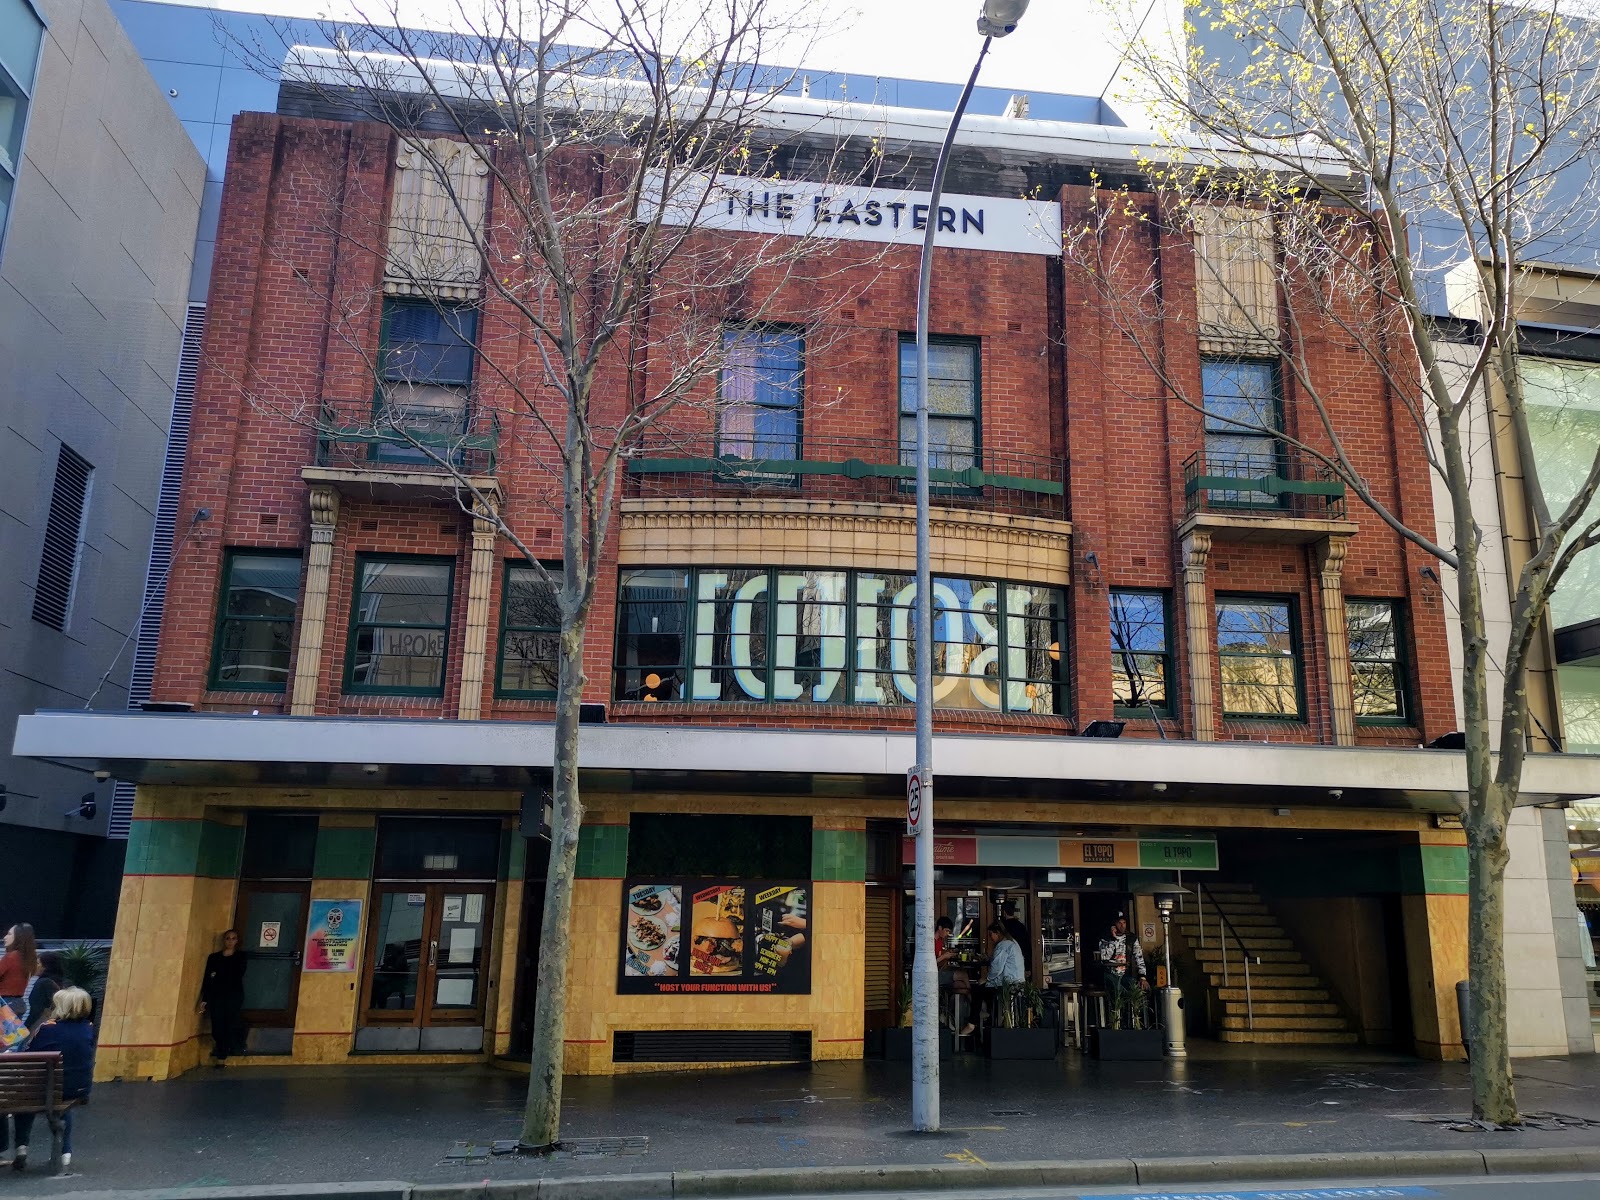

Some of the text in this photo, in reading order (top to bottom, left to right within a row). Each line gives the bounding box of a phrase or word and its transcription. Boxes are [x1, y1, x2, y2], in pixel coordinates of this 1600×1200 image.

[722, 189, 984, 235] THE EASTERN
[910, 786, 919, 812] 25
[1084, 845, 1112, 858] EL TOPO
[1164, 846, 1192, 858] EL TOPO
[633, 886, 656, 900] TUESDAY
[758, 887, 781, 901] WEEKDAY
[681, 983, 700, 992] YOUR
[701, 983, 737, 992] FUNCTION
[738, 983, 757, 992] WITH
